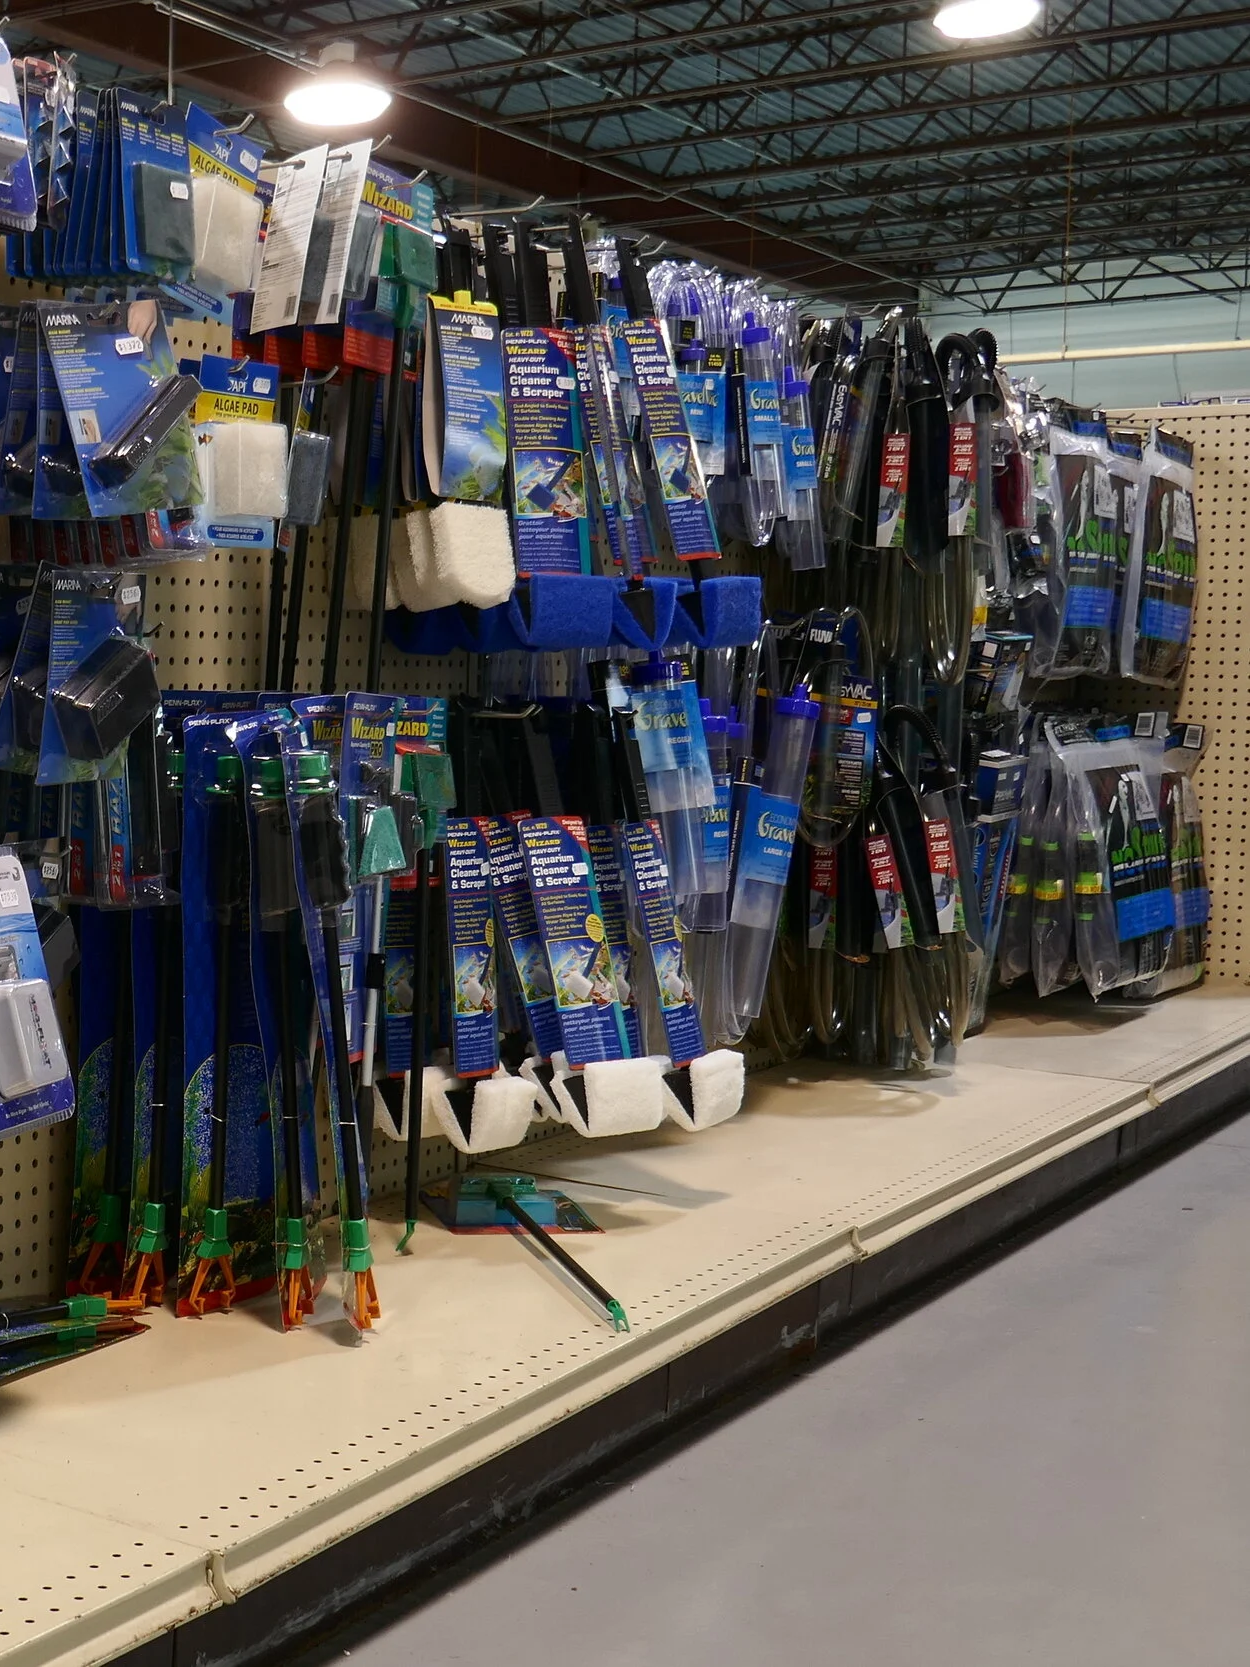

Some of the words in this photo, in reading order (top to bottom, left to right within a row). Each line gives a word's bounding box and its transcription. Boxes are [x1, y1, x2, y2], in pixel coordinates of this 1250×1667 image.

[194, 155, 221, 177] ALGAE
[222, 169, 239, 187] PAD
[362, 183, 414, 220] WIZARD
[46, 314, 81, 327] MARINA
[451, 313, 486, 327] MARINA
[627, 337, 657, 345] WIZARD
[506, 346, 547, 355] WIZARD
[633, 353, 668, 364] Aquarium
[509, 364, 559, 376] Aquarium
[635, 365, 665, 375] Cleaner
[510, 376, 551, 386] Cleaner
[638, 377, 646, 385] &
[511, 387, 519, 397] &
[523, 387, 564, 399] Scraper
[214, 398, 240, 413] ALGAE
[242, 402, 259, 415] PAD
[55, 579, 81, 591] MARINA
[840, 683, 872, 700] SYVAC
[164, 699, 201, 707] PENN-PLAX
[188, 718, 231, 727] PENN-PLAX
[351, 718, 385, 740] WIZARD
[396, 721, 429, 737] ZARD
[758, 811, 796, 845] Grave
[448, 840, 477, 848] WIZARD
[525, 839, 560, 848] WIZARD
[630, 843, 654, 852] WIZARD
[530, 847, 561, 855] HEAVY-DUTY
[763, 847, 783, 857] LARGE
[451, 856, 484, 868] Aquarium
[531, 854, 574, 866] Aquarium
[451, 869, 480, 878] Cleaner
[533, 866, 568, 876] Cleaner
[637, 870, 661, 880] Cleaner
[452, 880, 459, 889] &
[461, 880, 486, 889] Scraper
[536, 878, 544, 887] &
[546, 876, 581, 887] Scraper
[639, 882, 646, 891] &
